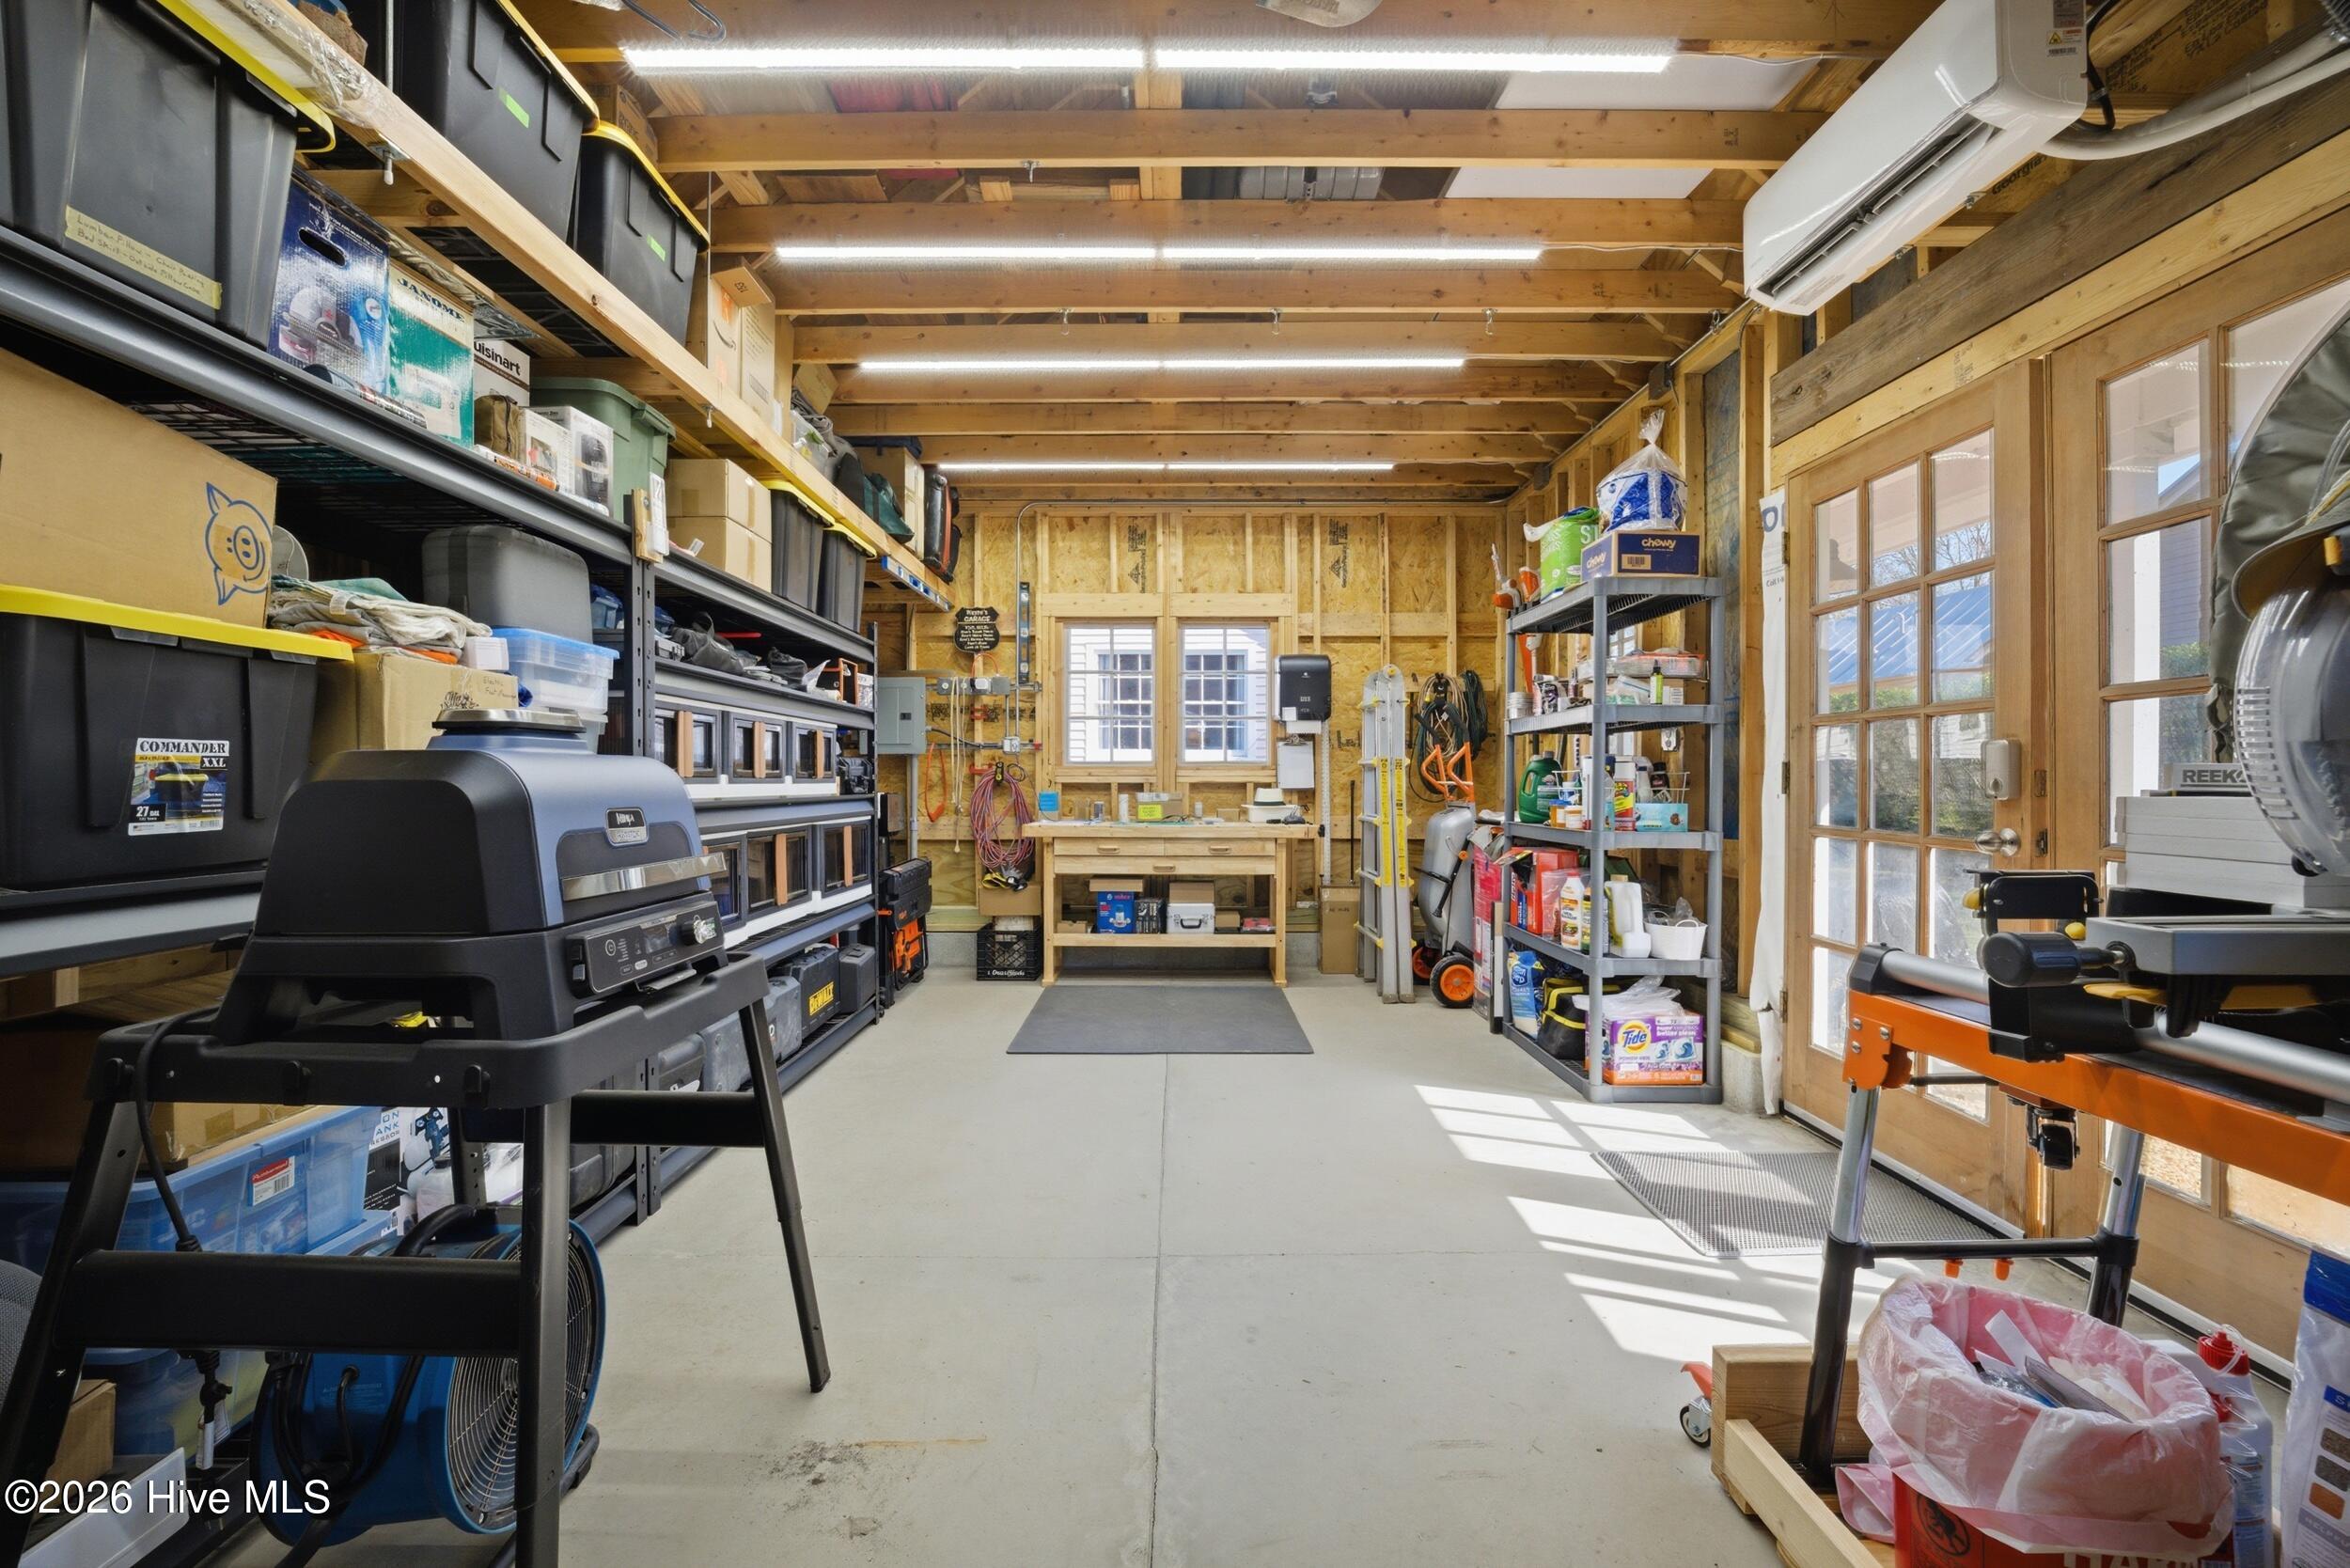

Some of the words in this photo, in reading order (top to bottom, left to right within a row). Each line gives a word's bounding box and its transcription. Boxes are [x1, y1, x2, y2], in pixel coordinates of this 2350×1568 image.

[398, 277, 465, 322] JANOME
[474, 341, 521, 376] uisinart
[1641, 537, 1677, 550] chewy
[1586, 551, 1607, 569] chewy
[139, 739, 227, 754] COMMANDER
[202, 758, 227, 768] XXL
[136, 806, 150, 818] 27
[809, 984, 835, 1015] DEWALT
[1622, 1029, 1648, 1048] Tide
[376, 1122, 400, 1136] ANK
